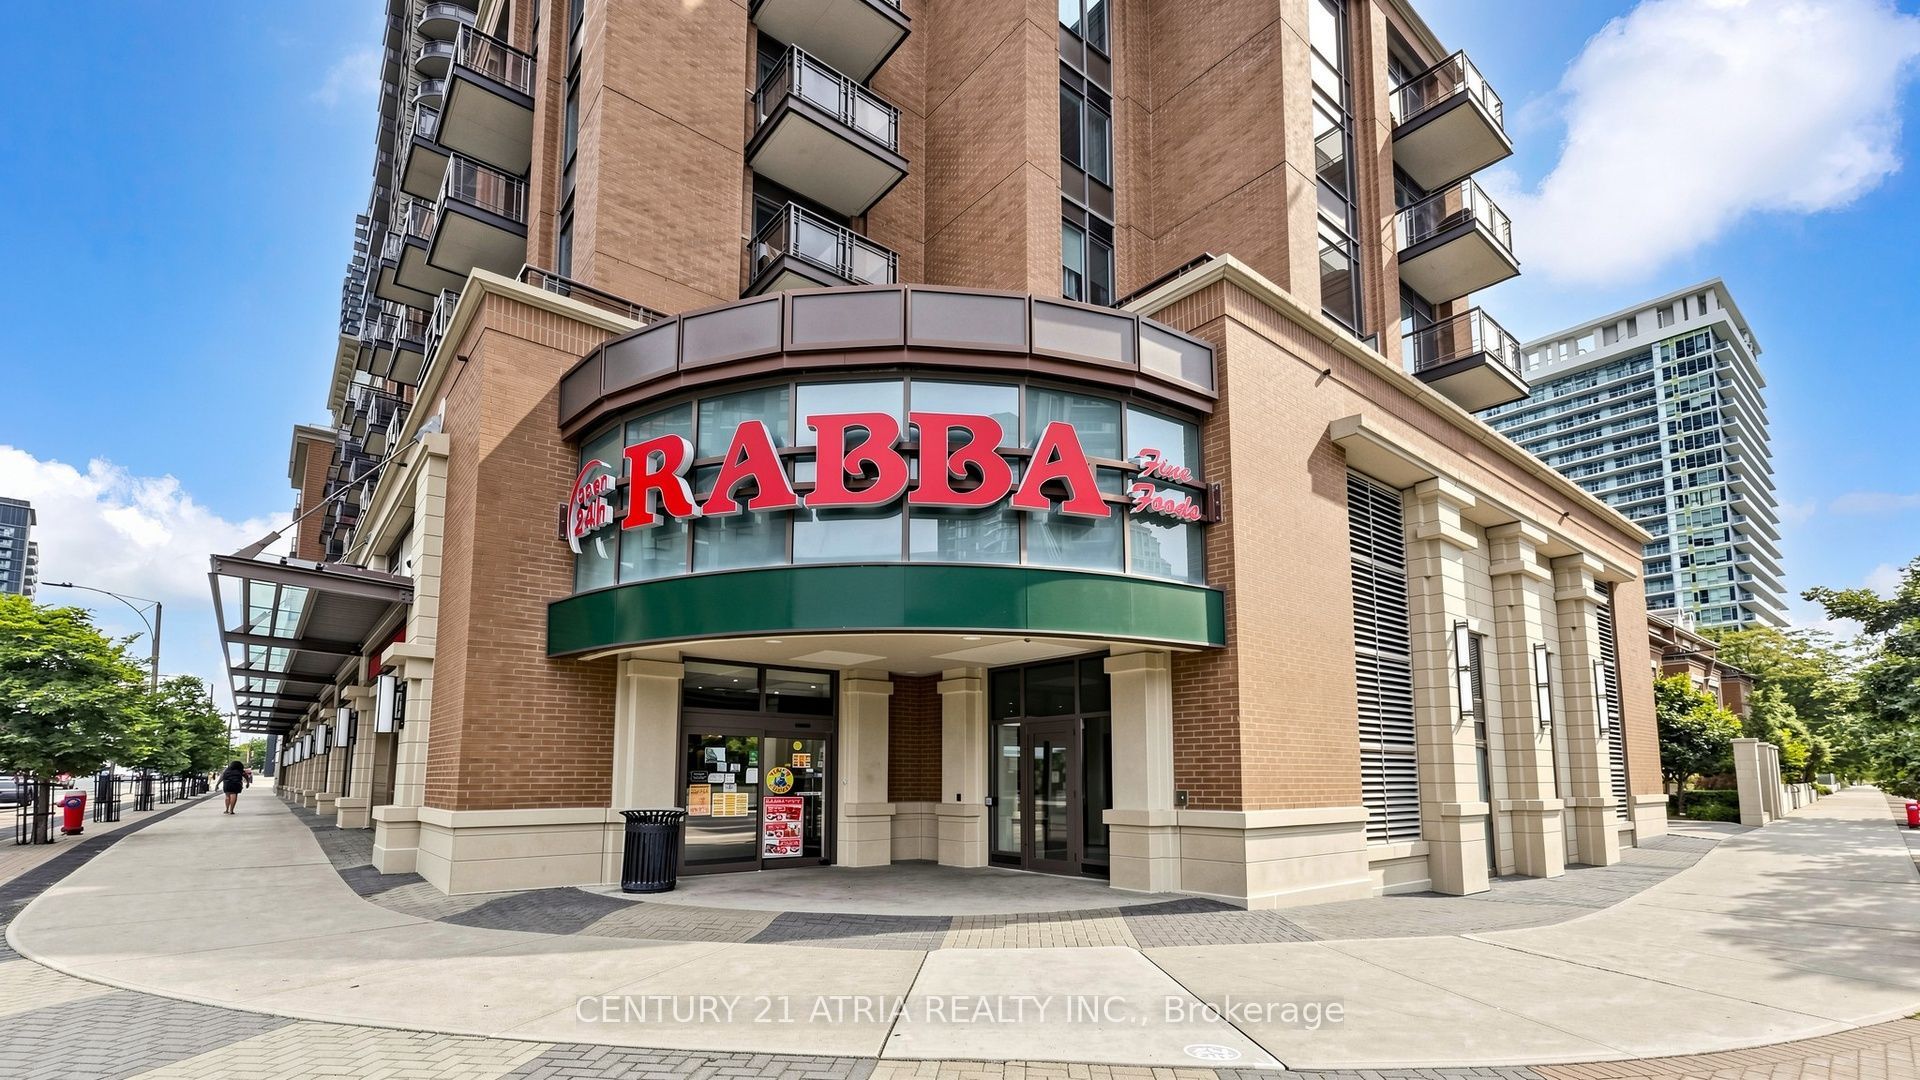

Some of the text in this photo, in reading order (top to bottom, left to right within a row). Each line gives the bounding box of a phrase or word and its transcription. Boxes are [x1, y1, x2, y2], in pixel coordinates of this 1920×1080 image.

[622, 411, 1112, 531] RABBA
[1137, 447, 1194, 483] Fine
[577, 474, 609, 506] open
[1131, 482, 1201, 520] Foods
